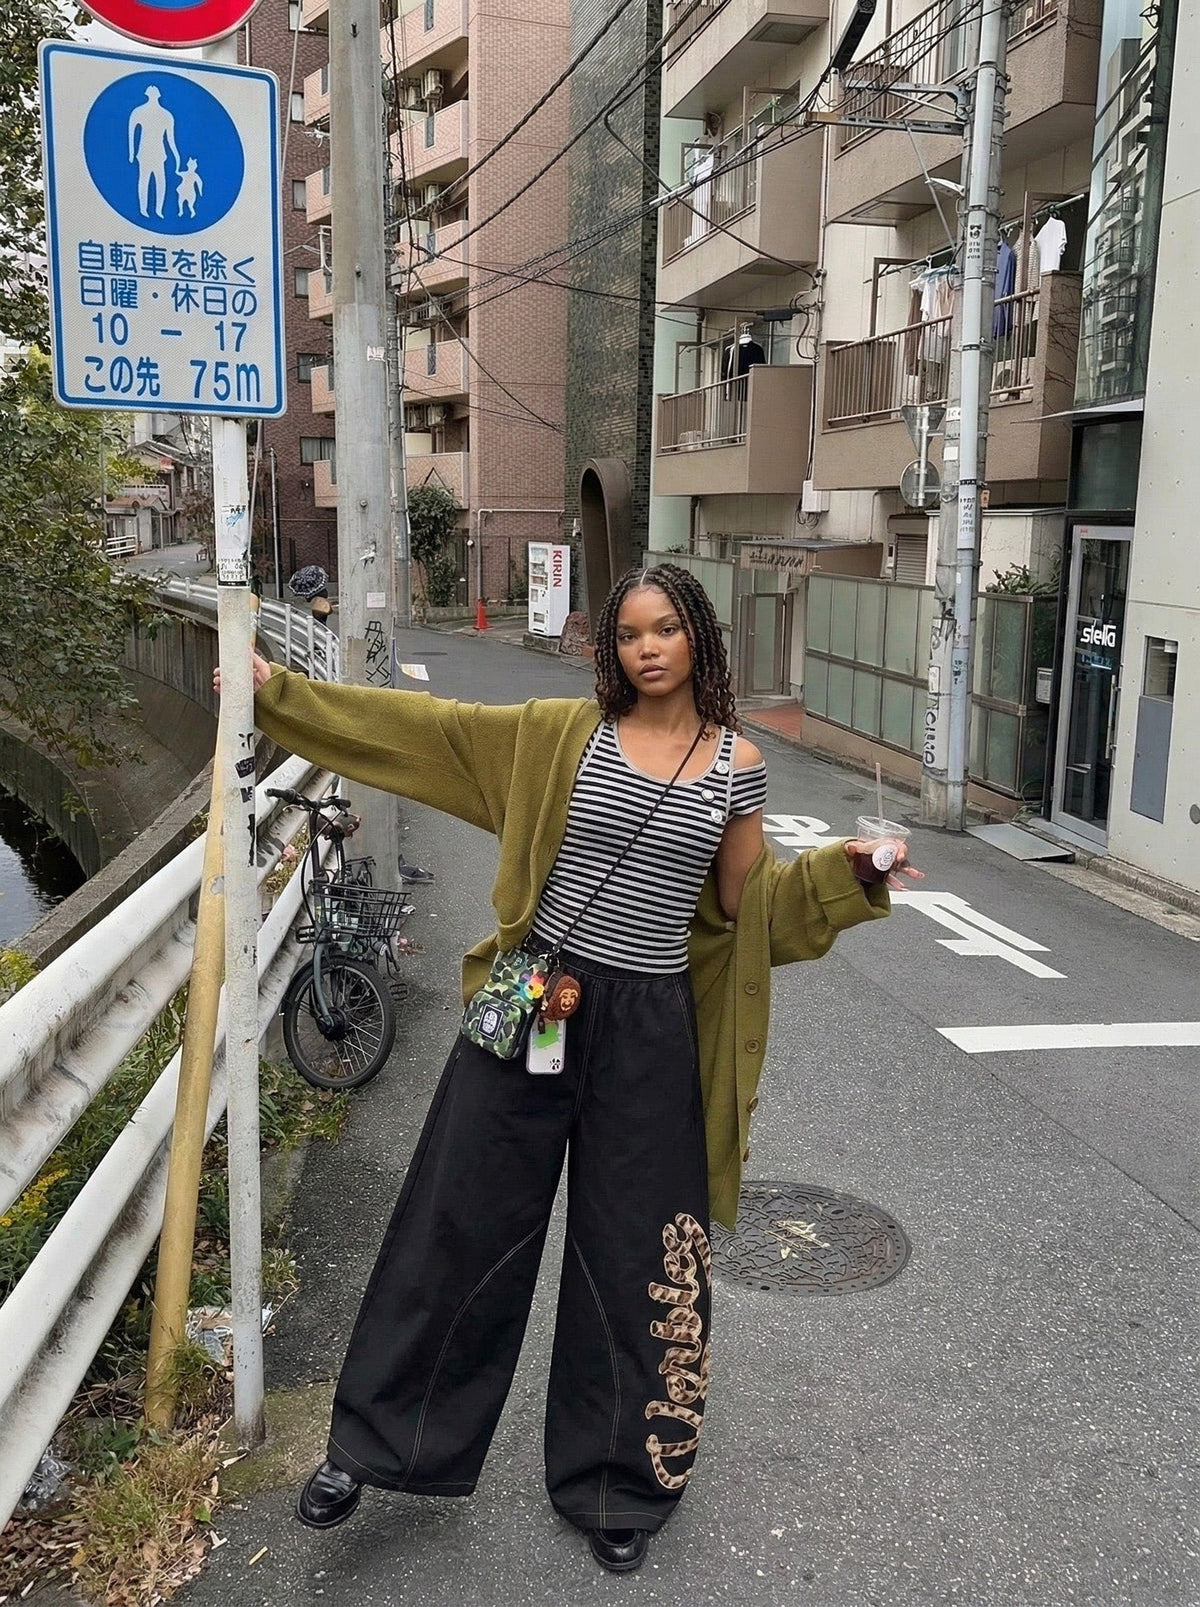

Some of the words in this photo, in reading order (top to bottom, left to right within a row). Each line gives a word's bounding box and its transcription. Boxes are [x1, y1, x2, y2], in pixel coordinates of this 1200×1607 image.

[78, 239, 255, 283] 自転車を除く
[80, 276, 257, 316] 日曜・休日の
[92, 312, 128, 345] 10
[214, 320, 248, 353] 17
[84, 355, 161, 397] この先
[190, 359, 261, 402] 75m
[553, 550, 562, 587] KIRIN
[1080, 619, 1117, 648] stella
